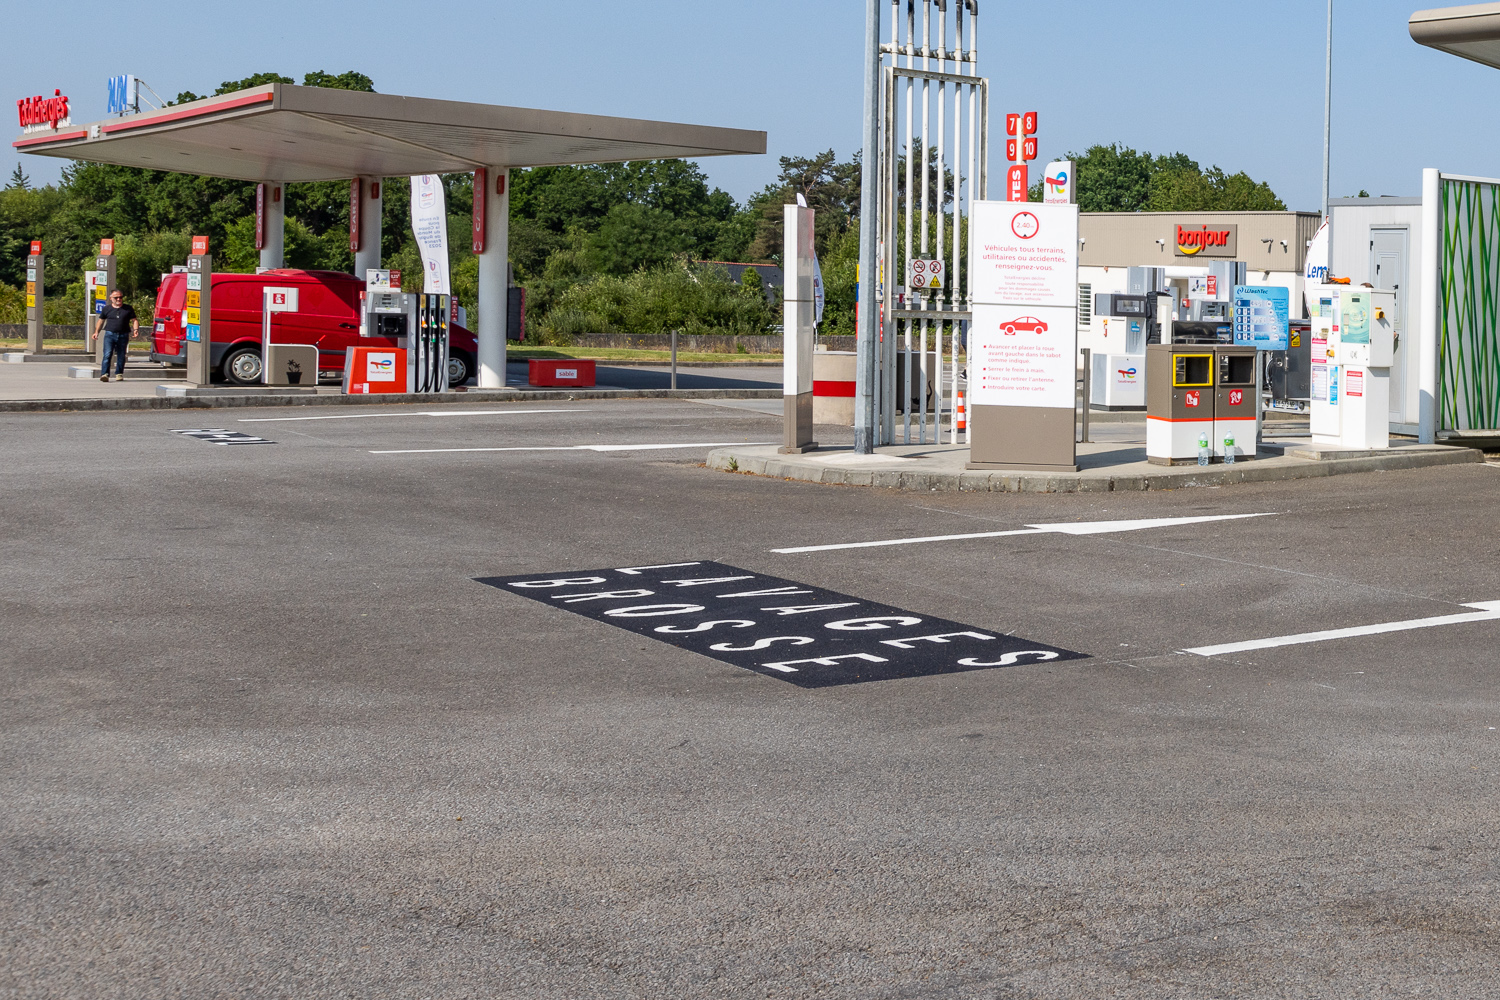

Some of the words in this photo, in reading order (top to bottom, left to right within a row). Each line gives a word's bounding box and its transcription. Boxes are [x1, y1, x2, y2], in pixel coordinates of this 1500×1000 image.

[16, 89, 68, 129] TotalEnergies
[1009, 117, 1016, 131] 7
[1026, 116, 1032, 130] 8
[1009, 143, 1015, 156] 9
[1024, 142, 1034, 156] 10
[1177, 225, 1230, 250] bonjour
[1029, 255, 1067, 263] accidentés,
[995, 263, 1054, 271] renseignez-vous.
[614, 561, 1060, 667] LAVAGES
[507, 576, 890, 674] BROSSE
